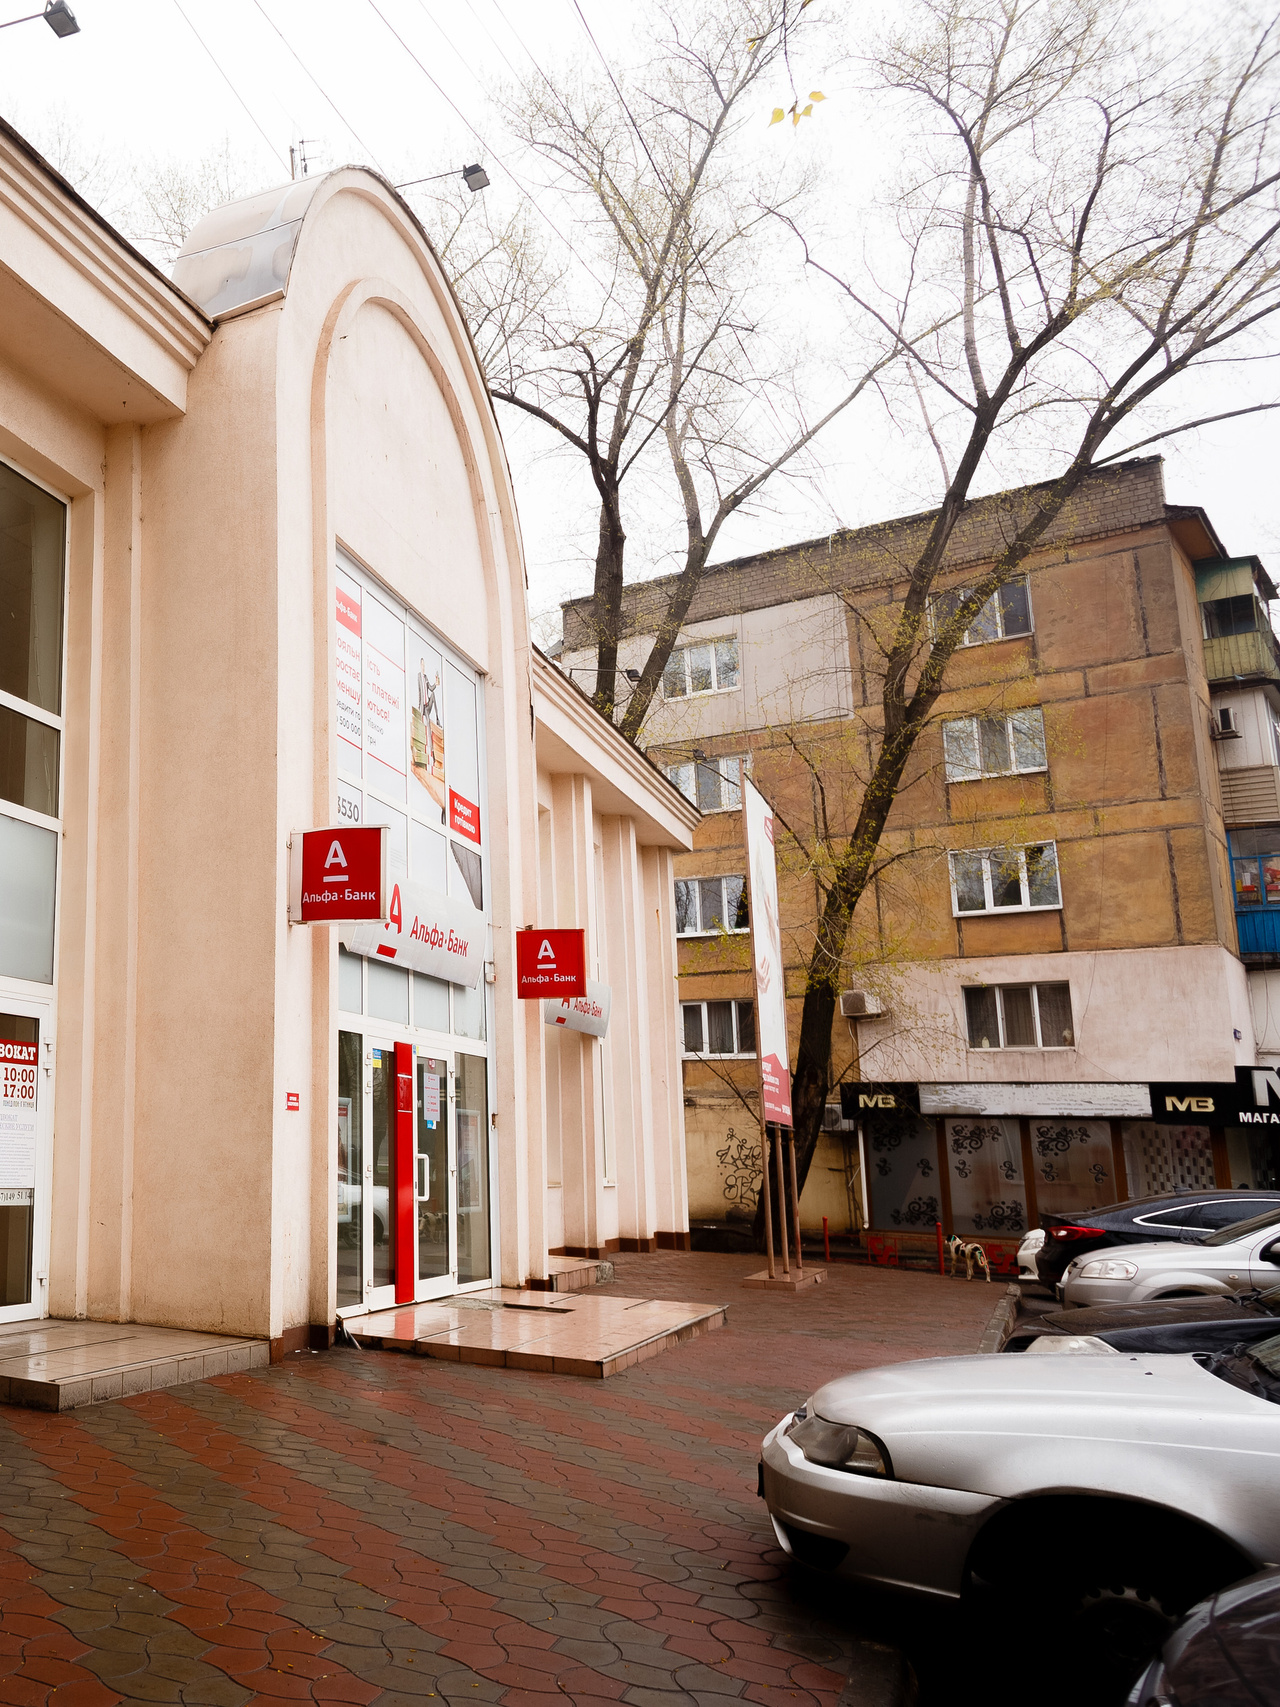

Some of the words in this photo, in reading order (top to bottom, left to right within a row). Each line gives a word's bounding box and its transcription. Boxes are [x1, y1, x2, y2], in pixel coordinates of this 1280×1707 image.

[337, 637, 361, 661] ояльн
[335, 657, 361, 682] ростає
[336, 679, 361, 706] меншу
[3, 1067, 35, 1083] 10:00
[3, 1083, 35, 1100] 17:00
